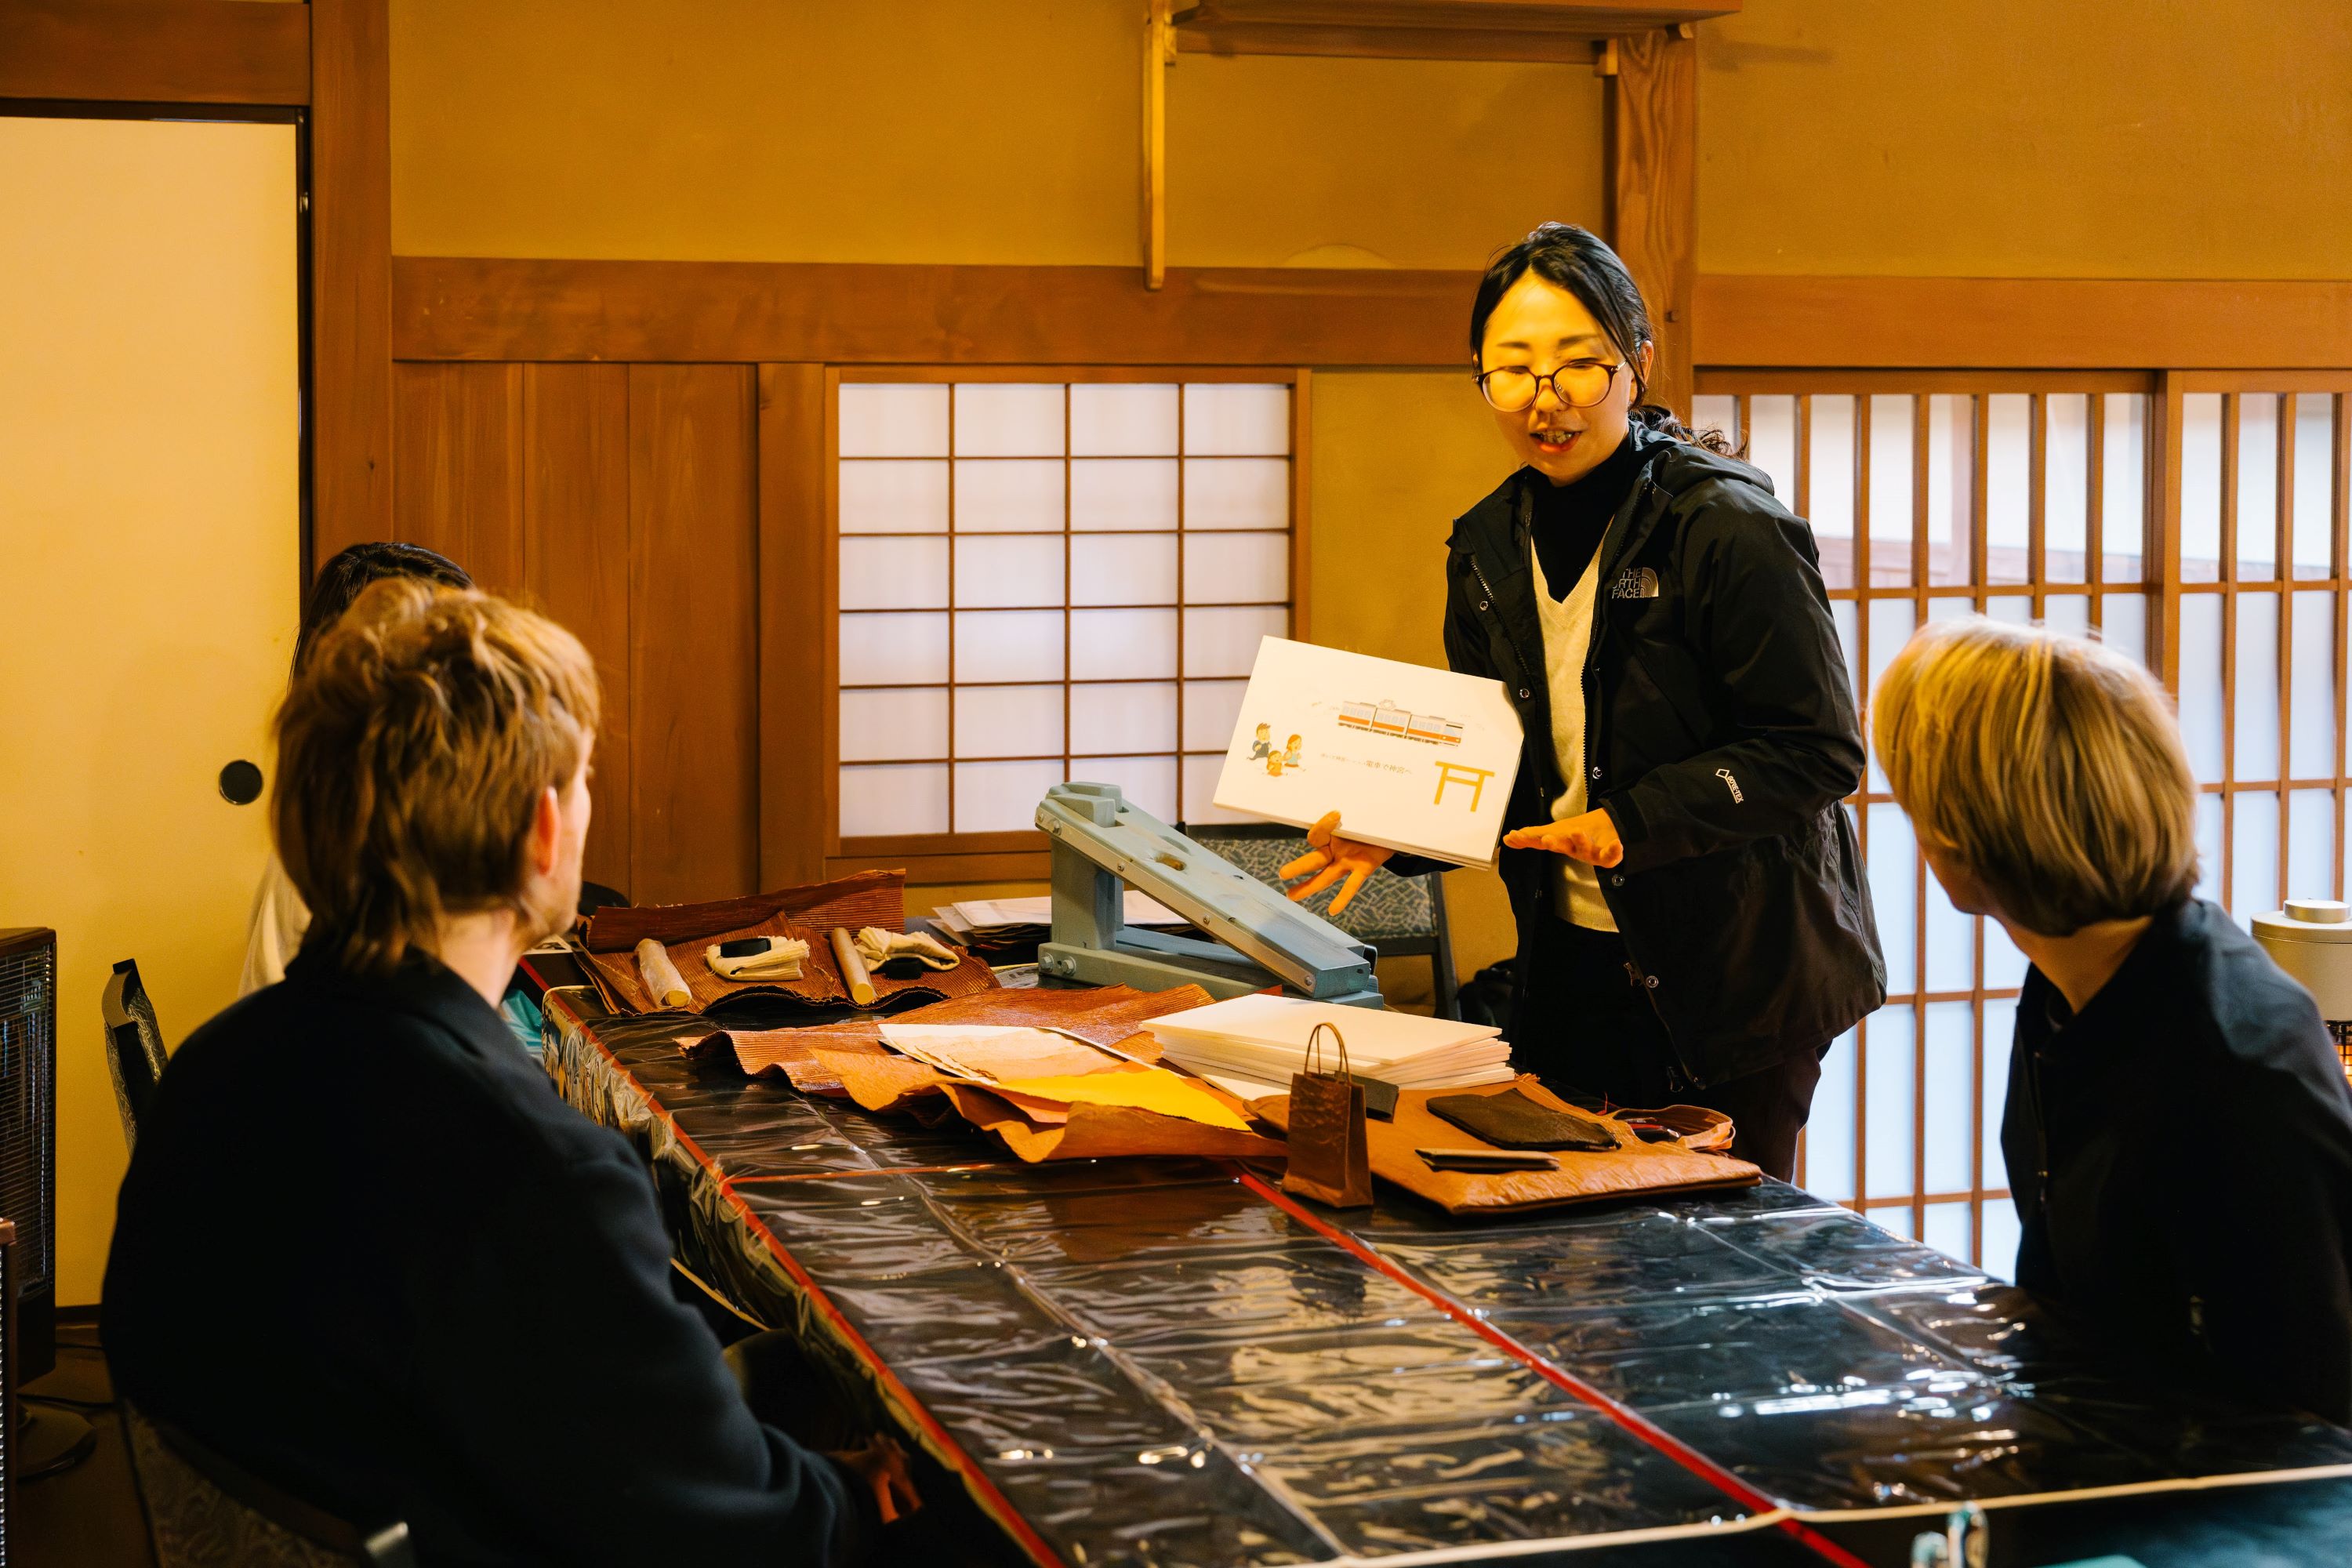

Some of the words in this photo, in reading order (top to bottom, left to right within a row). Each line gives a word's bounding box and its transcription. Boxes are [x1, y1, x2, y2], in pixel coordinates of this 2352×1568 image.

[1622, 568, 1641, 579] THE
[1612, 588, 1640, 599] FACE
[1727, 775, 1744, 803] GORE-TEX
